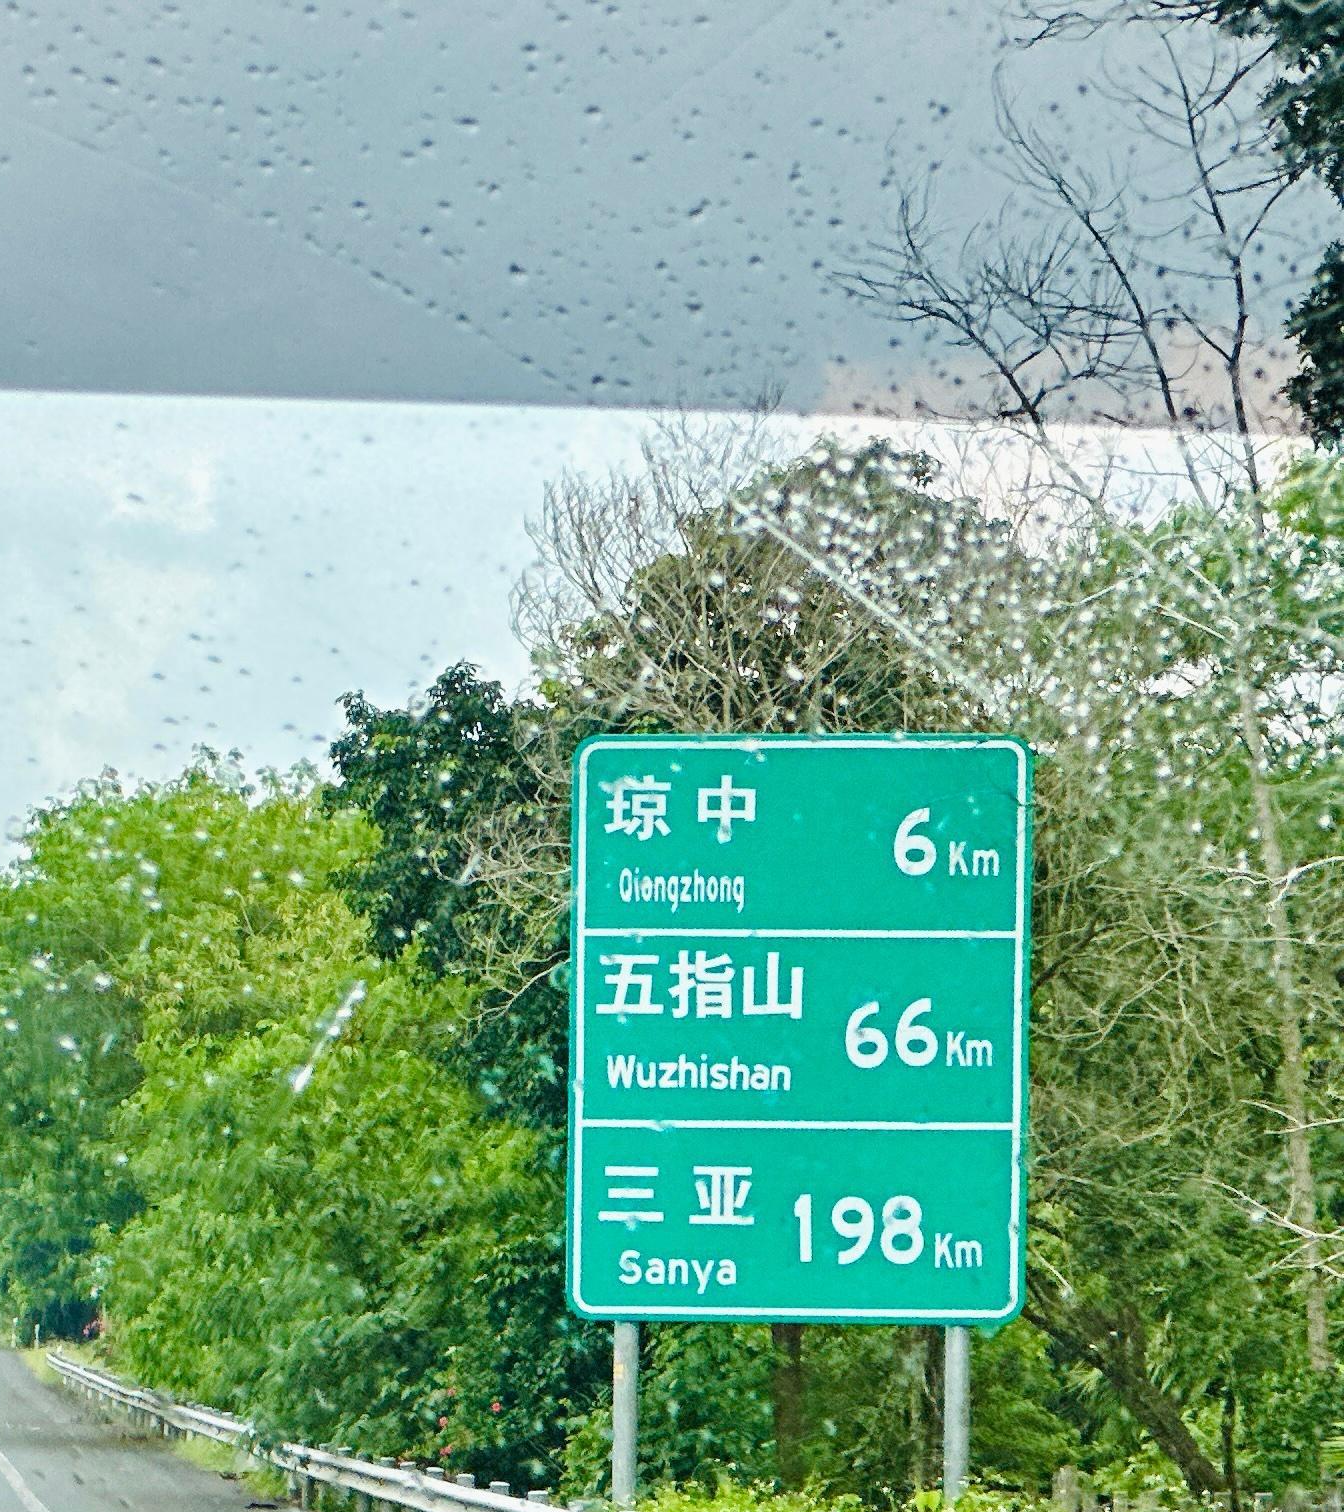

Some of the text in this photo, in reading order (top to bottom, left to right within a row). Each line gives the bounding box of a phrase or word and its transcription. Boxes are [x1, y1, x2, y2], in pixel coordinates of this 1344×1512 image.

[604, 775, 757, 843] 琼中
[893, 807, 1000, 877] 6 Km
[595, 949, 804, 1022] 五指山
[845, 997, 993, 1069] 66 Km
[607, 1053, 792, 1092] Wuzhishan
[598, 1165, 755, 1226] 三亚
[793, 1193, 983, 1268] 198 Km
[619, 1249, 737, 1294] Sanya
